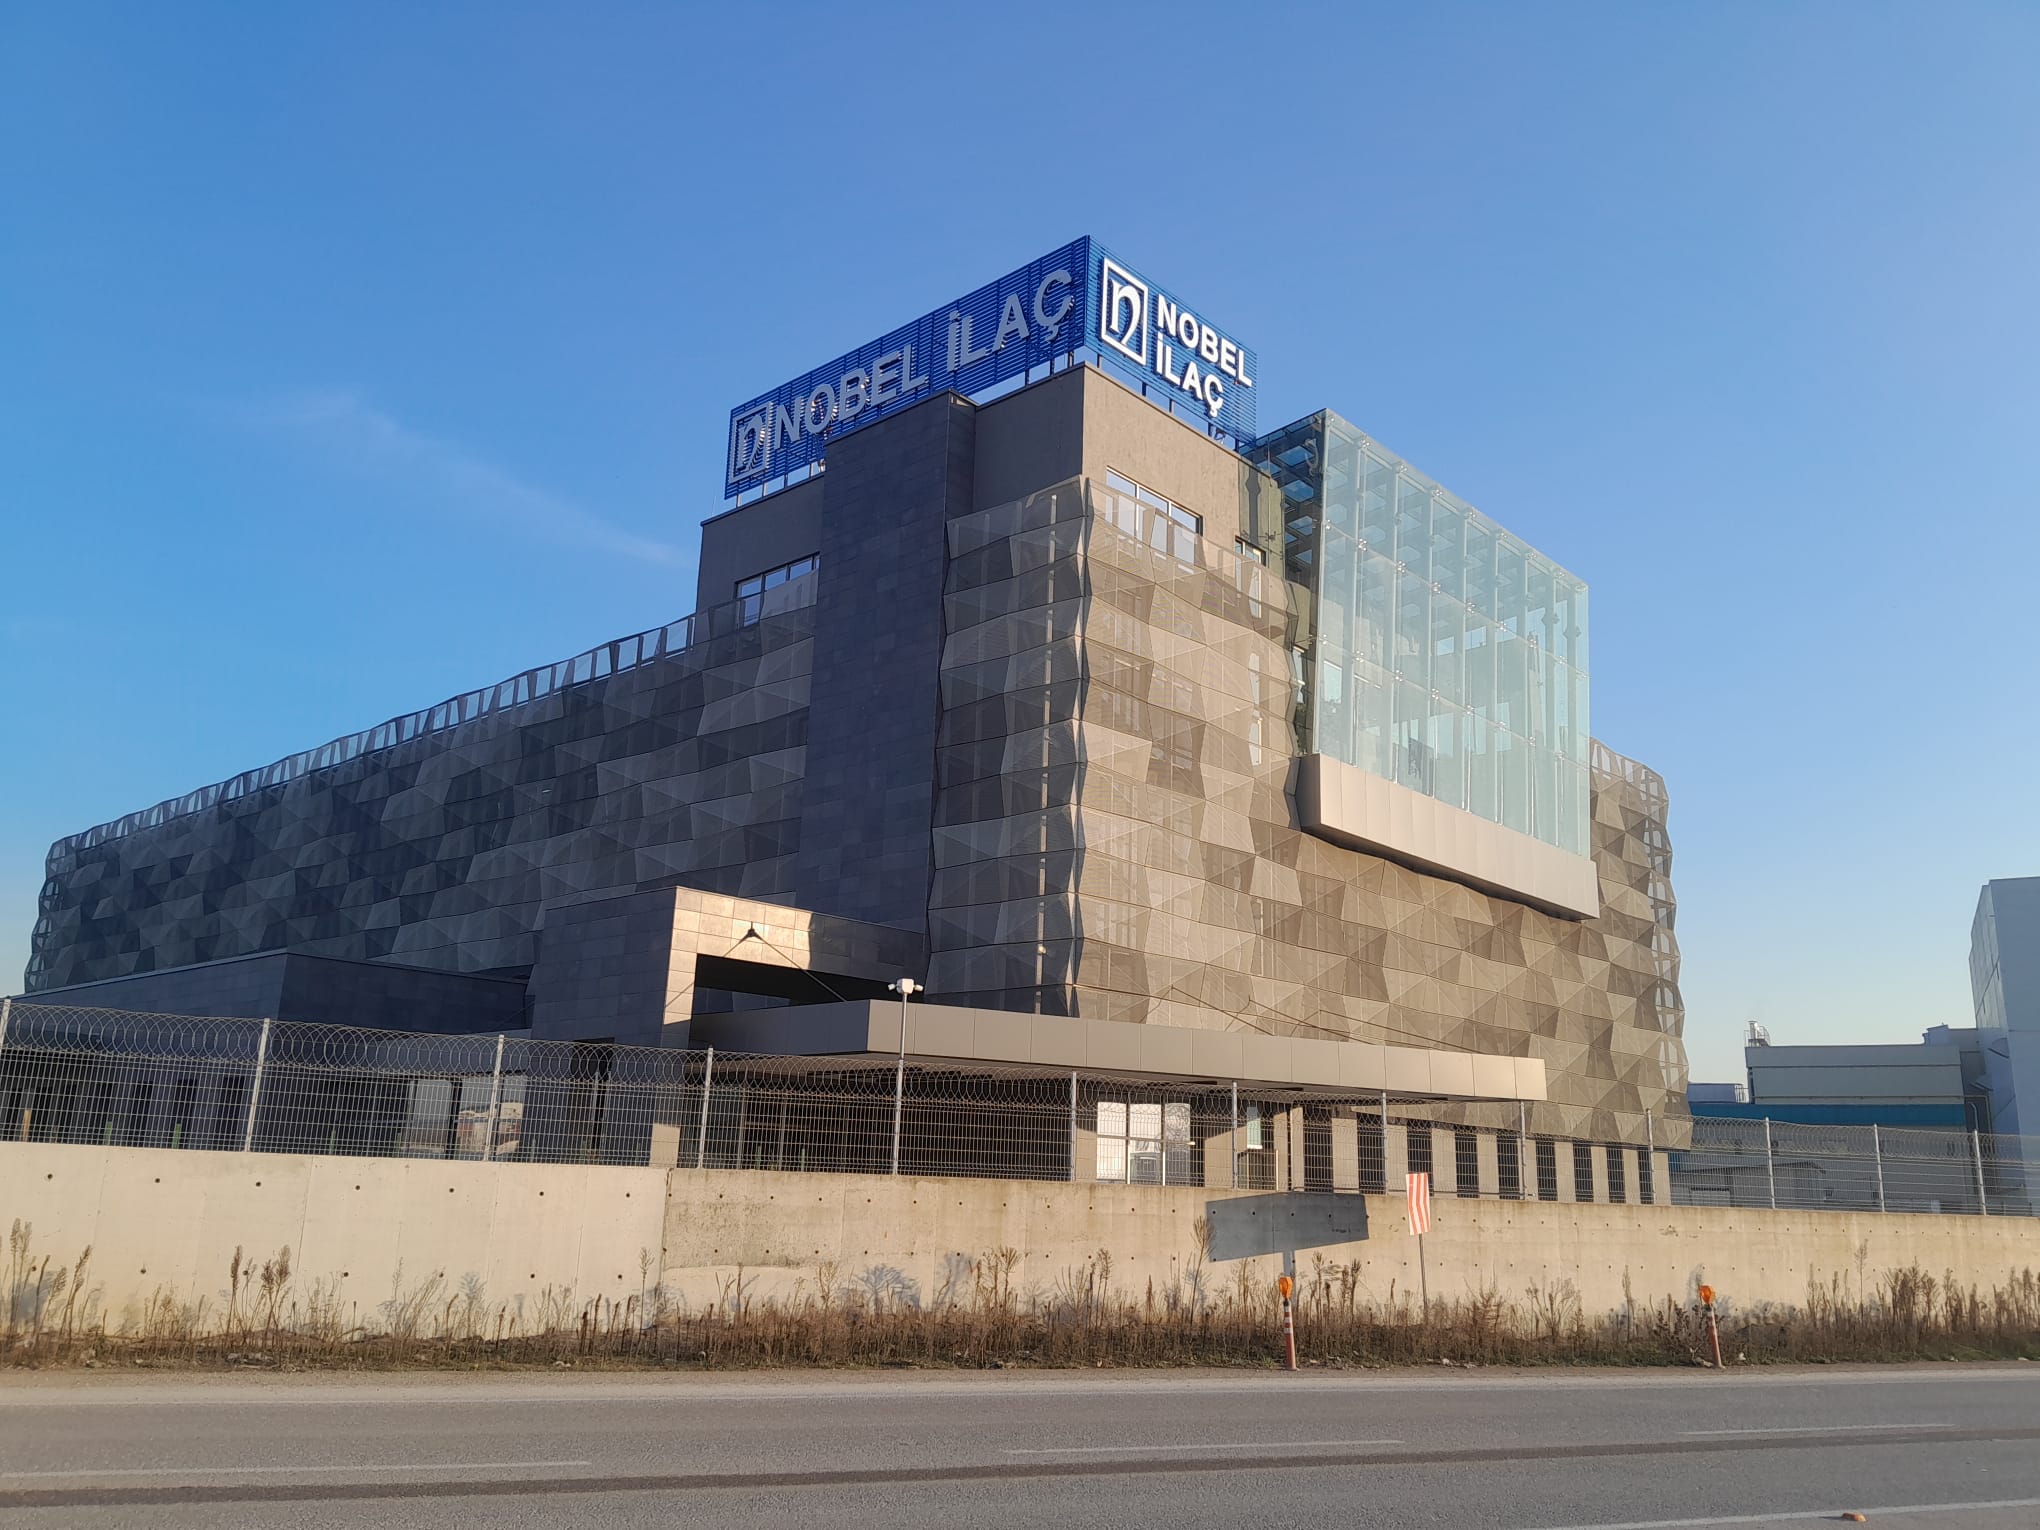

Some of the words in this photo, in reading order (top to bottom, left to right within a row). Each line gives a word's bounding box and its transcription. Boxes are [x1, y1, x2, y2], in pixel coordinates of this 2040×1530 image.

[775, 343, 929, 449] NOBEL
[946, 269, 1073, 373] İLAÇ
[1156, 331, 1224, 418] İLAÇ
[1157, 293, 1252, 387] NOBEL
